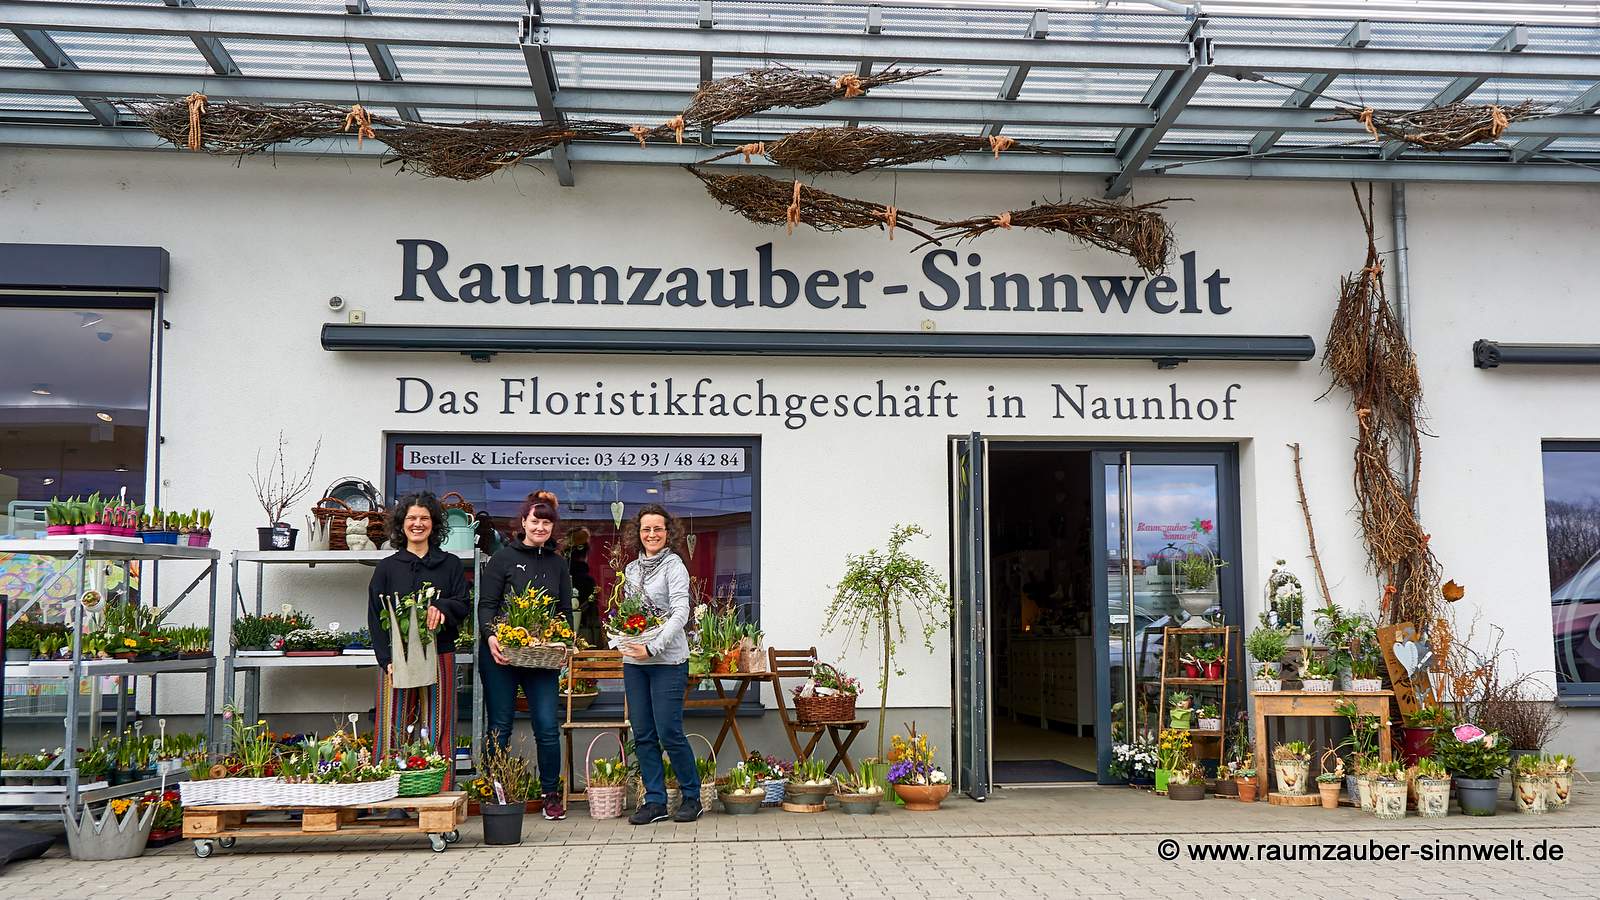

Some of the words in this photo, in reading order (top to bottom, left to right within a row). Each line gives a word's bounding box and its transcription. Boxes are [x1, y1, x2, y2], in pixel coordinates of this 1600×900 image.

[394, 238, 1232, 315] Raumzauber-Sinnwelt
[395, 376, 479, 415] Das
[499, 376, 959, 430] Floristikfachgeschäft
[986, 385, 1027, 419] in
[1051, 383, 1242, 421] Naunhof
[409, 450, 467, 465] Bestell-
[471, 451, 486, 465] &
[491, 451, 590, 466] Lieferservice:
[594, 452, 613, 467] 03
[617, 451, 637, 466] 42
[640, 453, 660, 467] 93
[663, 452, 670, 466] /
[673, 452, 693, 467] 48
[697, 453, 716, 467] 42
[720, 453, 739, 467] 84
